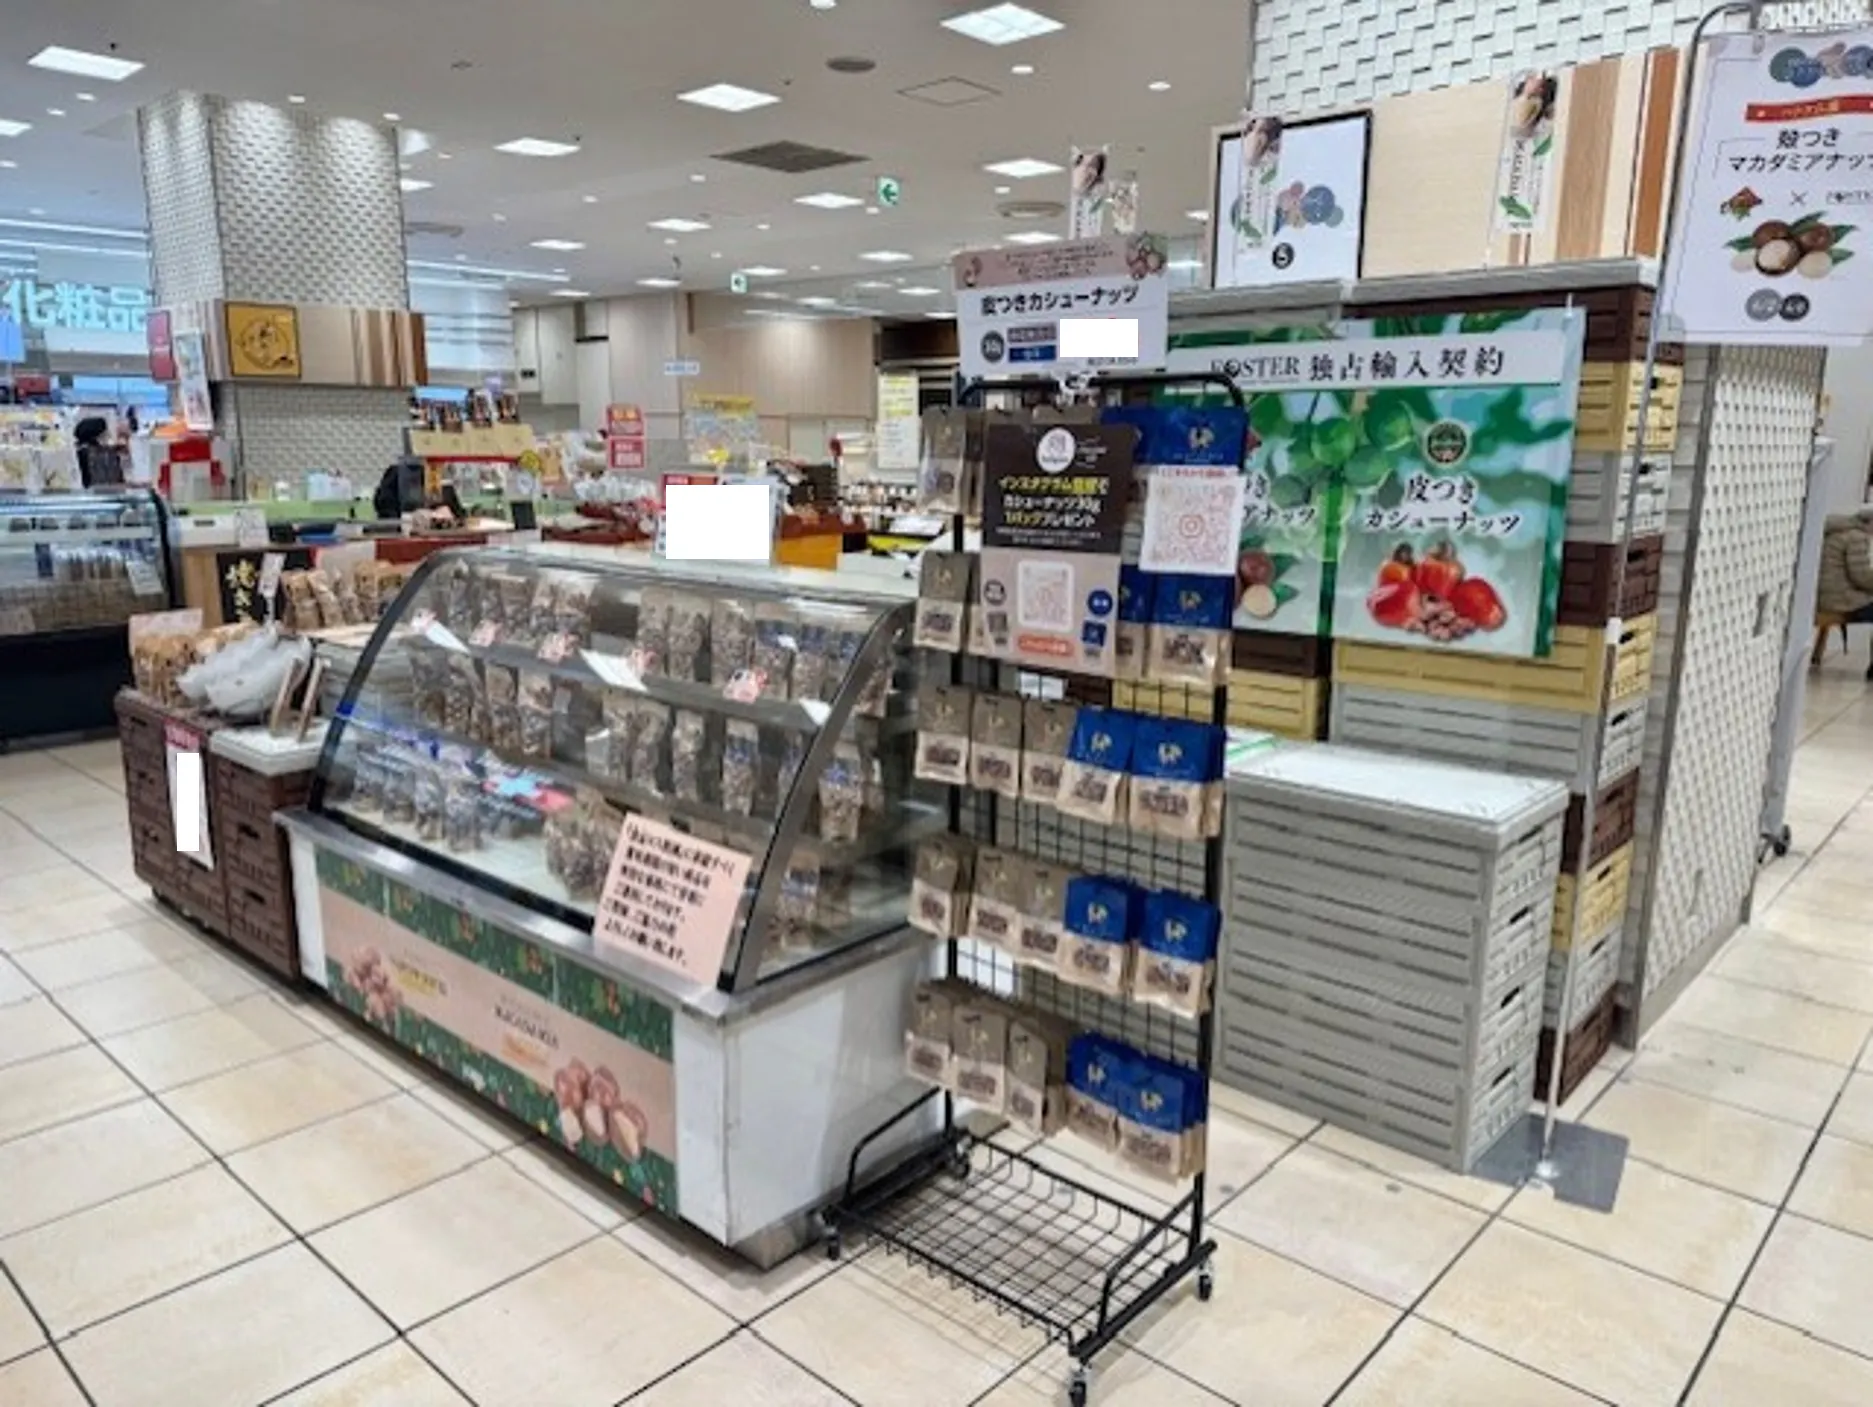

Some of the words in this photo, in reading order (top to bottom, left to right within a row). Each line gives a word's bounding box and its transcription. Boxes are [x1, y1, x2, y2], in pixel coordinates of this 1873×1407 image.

[1777, 127, 1841, 150] 殻つき
[2, 280, 150, 332] 化粧品
[1309, 345, 1504, 381] 独占輸入契約
[1405, 475, 1477, 503] 皮つき
[1365, 510, 1523, 535] カシューナッツ
